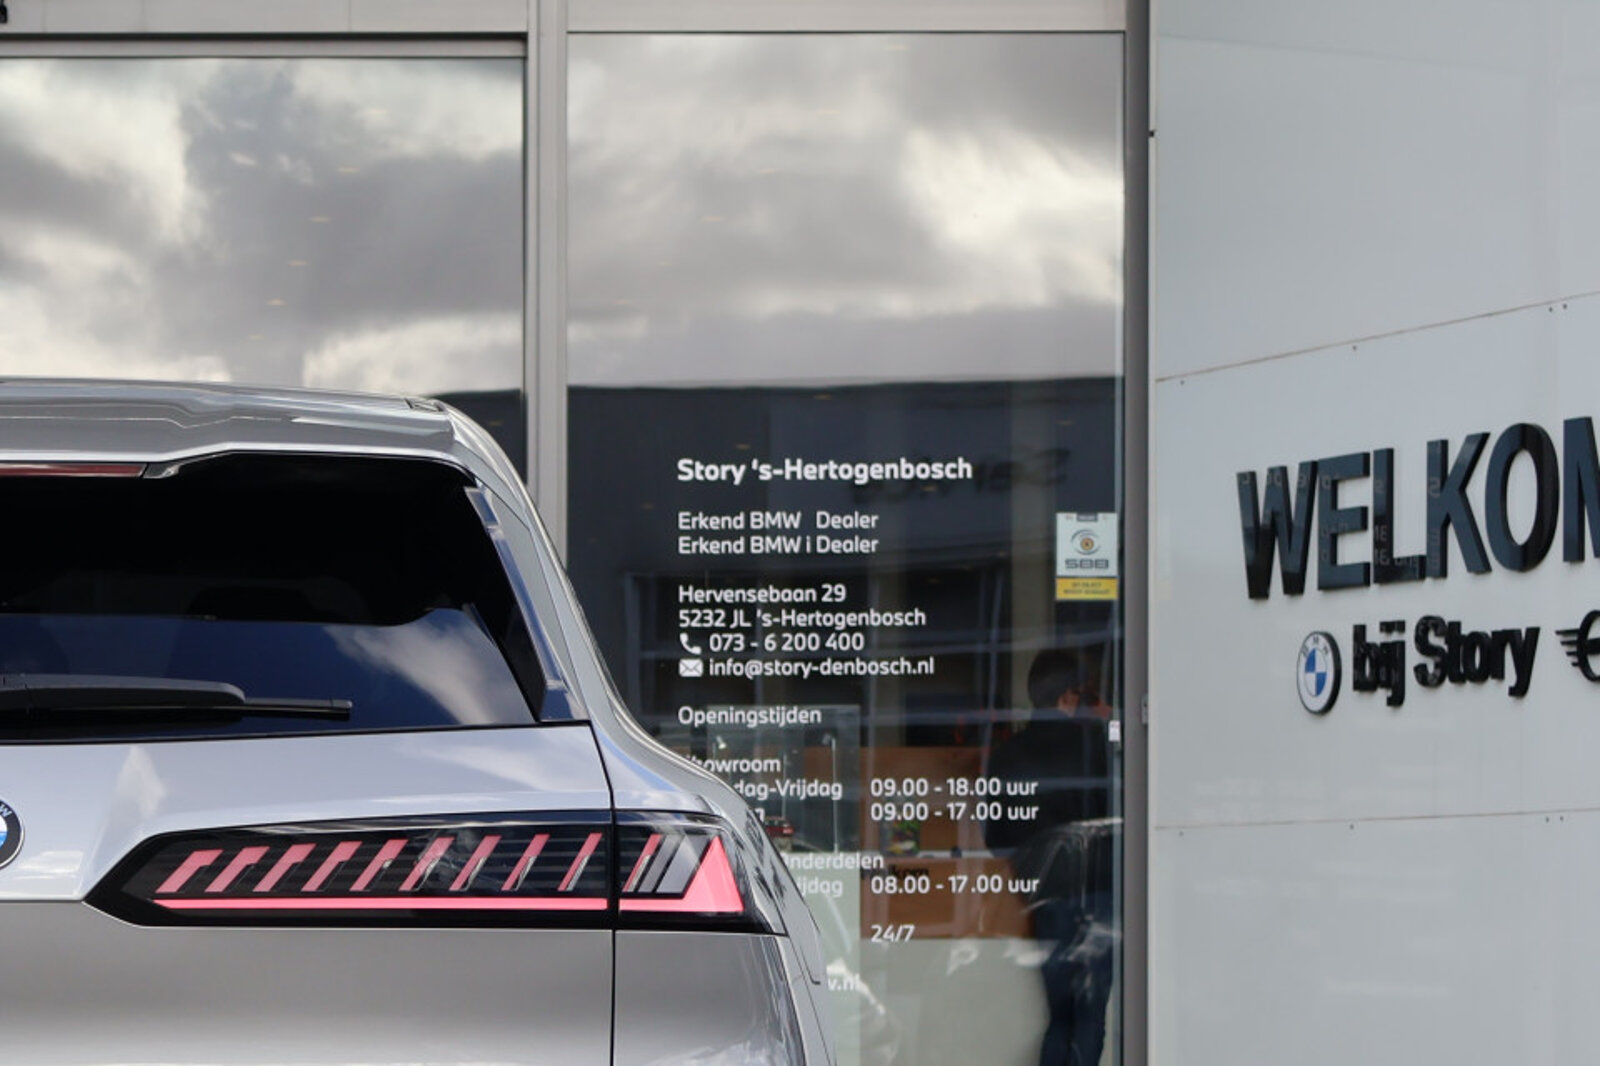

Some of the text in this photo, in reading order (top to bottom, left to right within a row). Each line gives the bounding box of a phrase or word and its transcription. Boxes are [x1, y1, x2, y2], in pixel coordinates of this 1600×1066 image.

[677, 458, 747, 486] Story
[678, 511, 879, 530] Erkend BMW Dealer
[678, 535, 879, 554] Erkend BMW i Dealer
[678, 584, 847, 603] Hervensebaan 29
[679, 608, 726, 628] 5232
[729, 608, 752, 628] JL
[709, 632, 745, 651] 073
[764, 632, 777, 651] 6
[781, 632, 821, 651] 200
[824, 632, 865, 651] 400
[709, 656, 935, 680] info@story-denbosch.nl
[1353, 615, 1540, 707] bij Story
[678, 705, 822, 728] Openingstijden
[733, 779, 843, 801] dag-Vrijdag
[870, 777, 929, 797] 09.00
[946, 777, 1002, 796] 18.00
[1006, 781, 1039, 796] uur
[870, 802, 929, 821] 09.00
[1007, 806, 1039, 820] uur
[870, 875, 931, 895] 08.00
[1007, 879, 1040, 893] uur
[870, 924, 916, 943] 24/7
